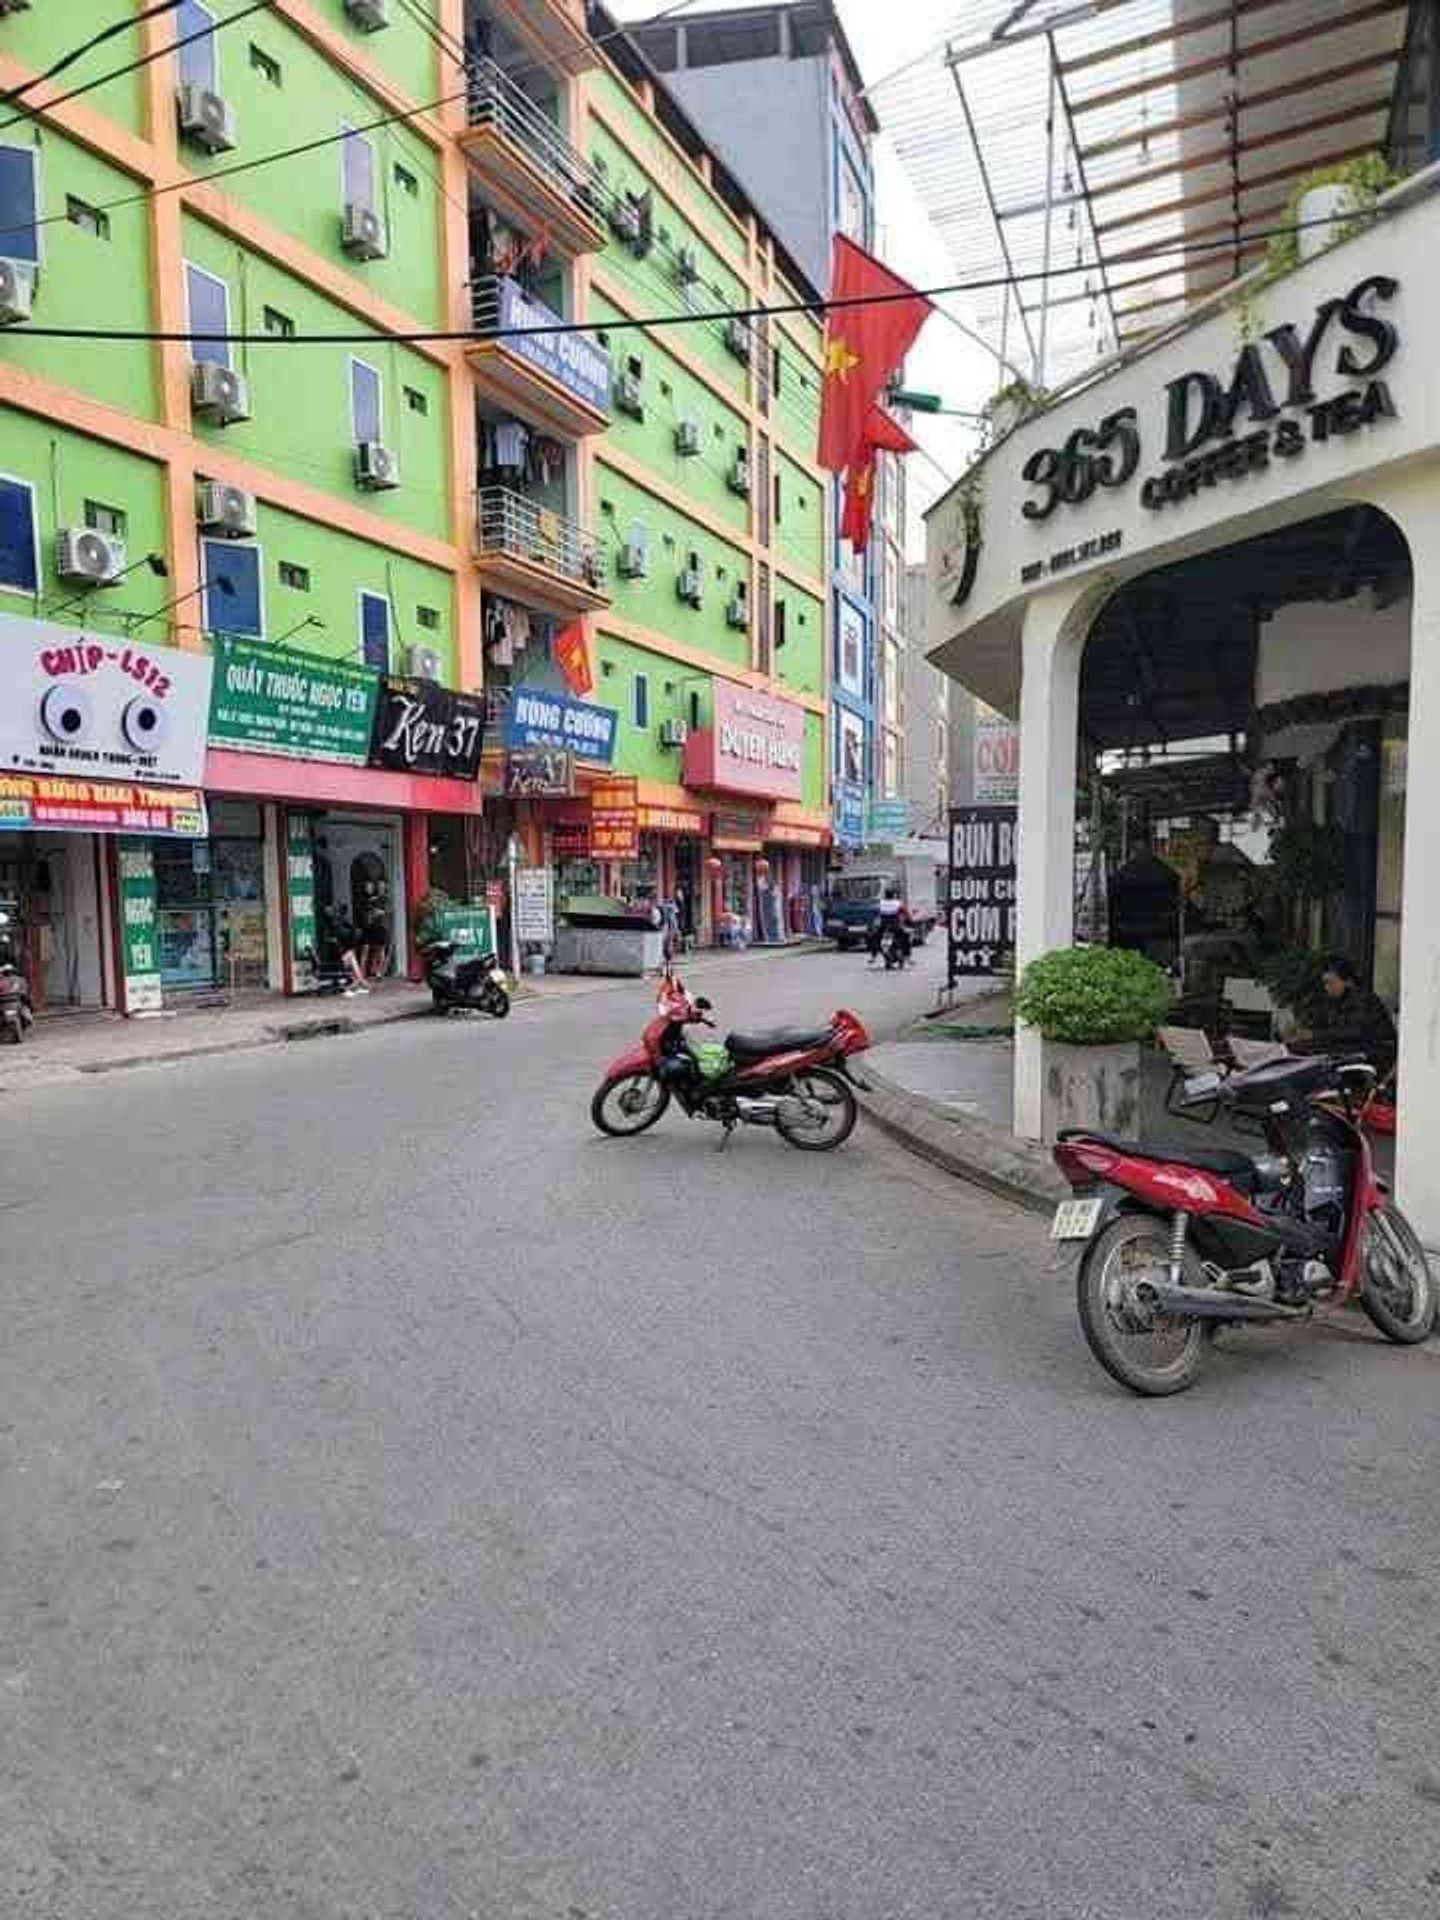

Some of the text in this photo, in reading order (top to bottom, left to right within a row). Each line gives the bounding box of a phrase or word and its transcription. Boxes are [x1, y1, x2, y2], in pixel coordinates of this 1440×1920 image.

[1022, 276, 1400, 520] 365 DAYS
[384, 695, 445, 762] Ken
[447, 715, 480, 757] 37
[953, 812, 993, 867] BÚN
[951, 877, 988, 899] BÚN
[951, 903, 1000, 942] CƠM
